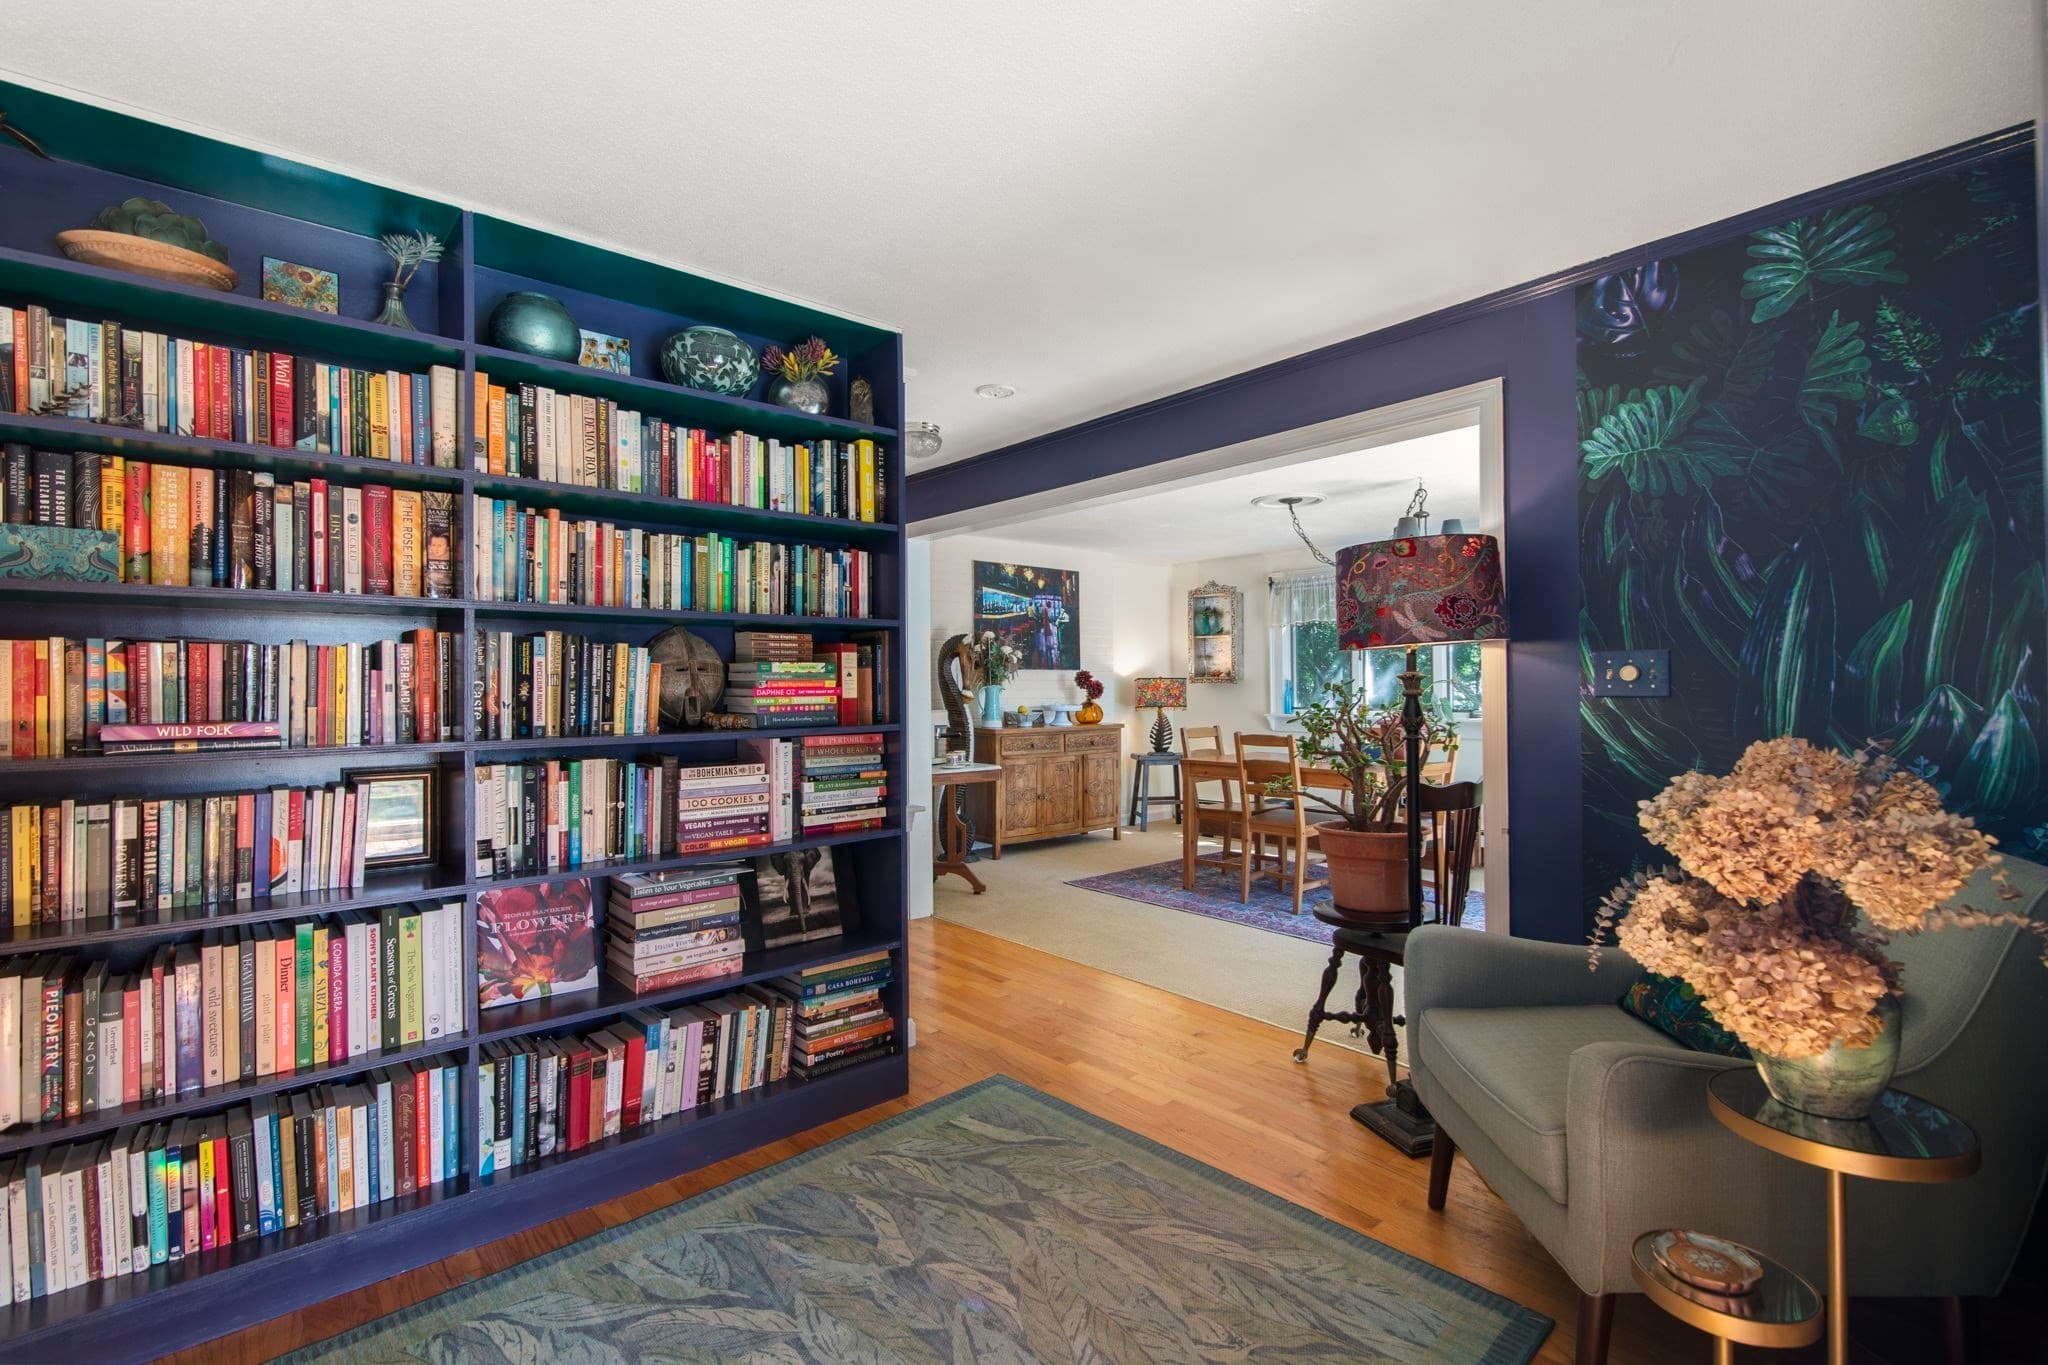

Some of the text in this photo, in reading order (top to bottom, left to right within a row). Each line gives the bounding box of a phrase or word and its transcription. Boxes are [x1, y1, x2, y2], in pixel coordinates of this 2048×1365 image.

[15, 337, 28, 363] Martel
[257, 359, 266, 378] CIRCE
[275, 359, 291, 414] Wolf Hall
[257, 383, 266, 414] MADELINE
[526, 426, 536, 465] blank slate
[584, 416, 597, 478] DEMON BOX
[9, 461, 18, 497] PORTRAIT
[16, 454, 26, 506] THE MARRIAGE
[38, 473, 50, 522] ELIZABETH
[55, 469, 66, 527] THE ABSOLUT
[167, 502, 178, 530] SONGS
[217, 519, 225, 547] RICHARD
[255, 490, 265, 568] HOSSEINI ECHOED
[331, 514, 342, 541] LOST
[402, 504, 413, 581] THE ROSE FIELD
[217, 549, 225, 574] POWERS
[90, 652, 100, 679] INLAND
[477, 646, 486, 666] Isabel
[400, 647, 411, 703] UNDERLAND
[442, 662, 450, 691] MOUNTAIN
[536, 661, 545, 722] MYCELIUM RUNNING
[756, 688, 796, 697] DAPHNE OZ
[473, 680, 486, 721] Caste
[156, 722, 234, 738] WILD FOLK
[817, 745, 875, 756] WHOLE BEAUTY
[696, 766, 738, 778] BOHEMIANS
[792, 758, 801, 791] FEAST
[289, 802, 297, 831] PAMUK
[494, 770, 506, 841] How We Die
[572, 793, 580, 819] ADVISOR
[686, 797, 708, 809] 100
[710, 795, 754, 807] COOKIES
[1, 815, 9, 848] HAMNET
[144, 809, 158, 876] PARIS BOOK
[190, 803, 200, 858] ANN PATCHETT
[684, 820, 713, 830] VEGAN'S
[691, 829, 715, 840] VEGAN
[684, 842, 711, 851] COLOR
[114, 845, 129, 897] POWERS
[159, 853, 172, 894] Patchett
[633, 878, 711, 897] Listen to Your Vegetables
[490, 910, 587, 935] FLOWERS
[279, 957, 293, 993] Dinner
[332, 943, 343, 1013] COMIDA CASERA
[368, 927, 378, 1020] SOPH'S PLANT KITCHEN
[385, 937, 398, 1020] Seasons Greens
[405, 949, 418, 1024] The New Vegetarian
[826, 975, 875, 991] CASA BOHEMIA
[298, 948, 313, 1044] Boustany SAMI TAMIMI
[316, 978, 328, 1012] SABZI
[45, 990, 59, 1068] PIEOMETRY
[208, 986, 220, 1057] wild sweetness
[261, 993, 273, 1045] plant plate
[68, 1020, 80, 1090] rustic fruit desserts
[86, 1017, 97, 1076] GAZOZ
[110, 1026, 118, 1066] Greenfeast
[825, 1049, 845, 1059] Poetry
[499, 1075, 507, 1099] Wisdom
[499, 1100, 507, 1108] of
[381, 1098, 391, 1149] MIGRATIONS
[398, 1093, 415, 1129] Catherine
[498, 1120, 507, 1137] Body
